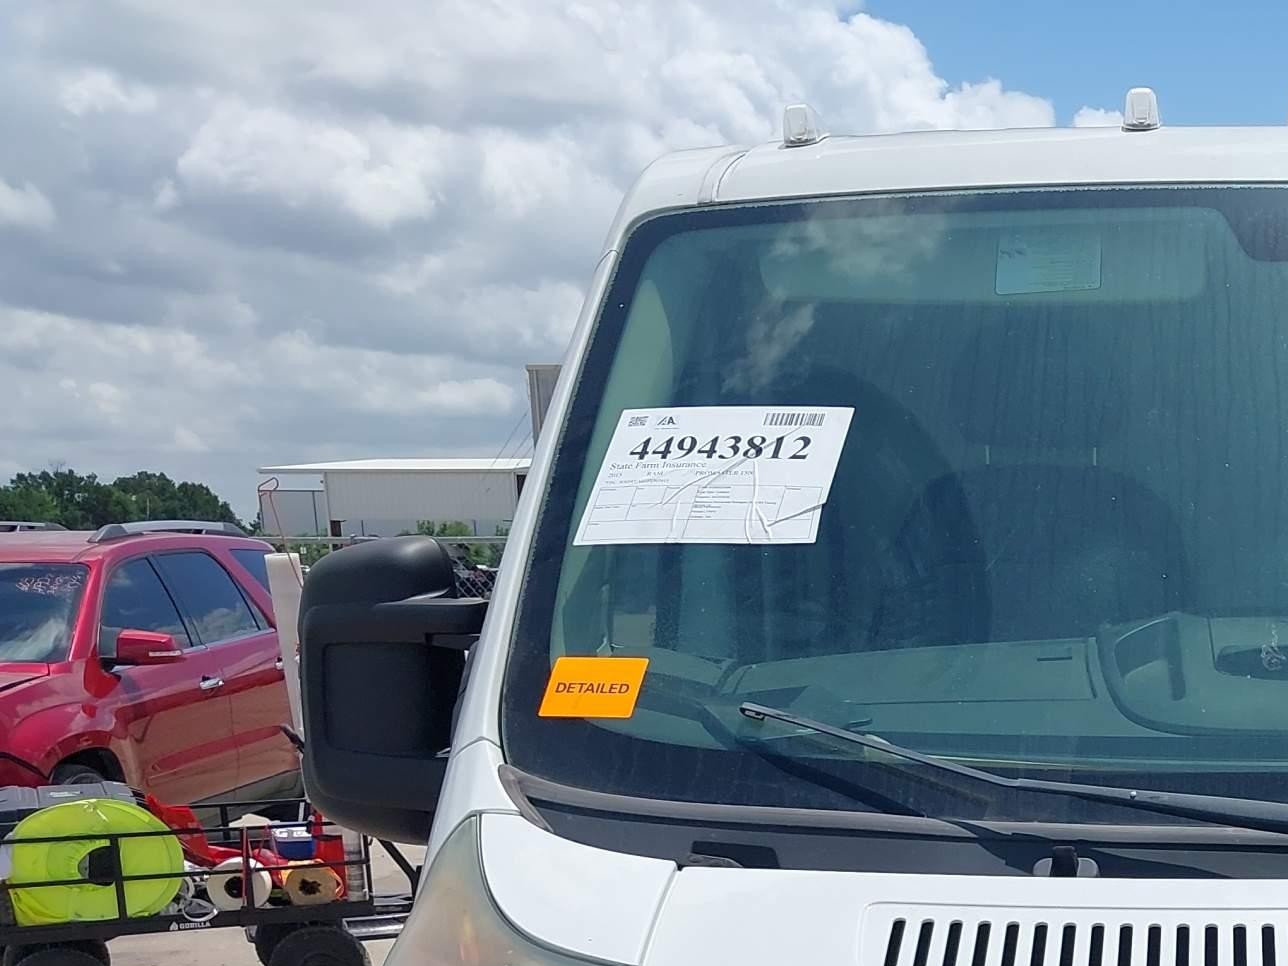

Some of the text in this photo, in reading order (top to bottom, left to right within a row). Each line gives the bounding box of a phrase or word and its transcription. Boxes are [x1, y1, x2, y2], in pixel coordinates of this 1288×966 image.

[629, 435, 812, 461] 44943812
[609, 461, 707, 471] State Farm Insurance
[555, 682, 630, 694] DETAILED
